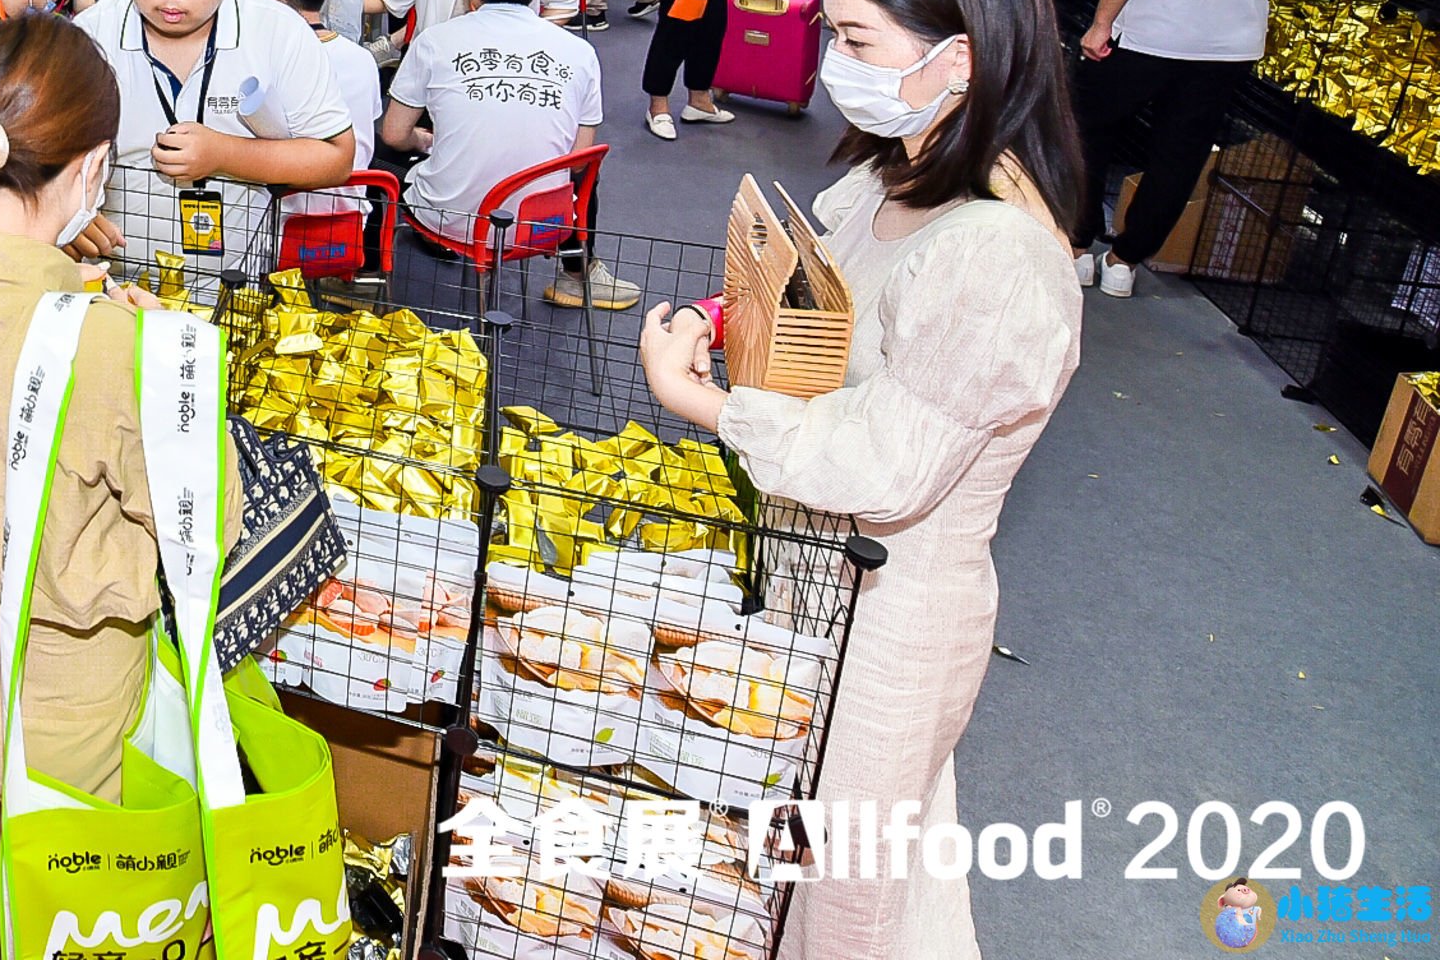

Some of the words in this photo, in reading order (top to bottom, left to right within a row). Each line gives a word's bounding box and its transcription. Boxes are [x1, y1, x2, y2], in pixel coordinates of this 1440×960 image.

[452, 48, 556, 77] 有零有食
[465, 79, 563, 110] 有你有我
